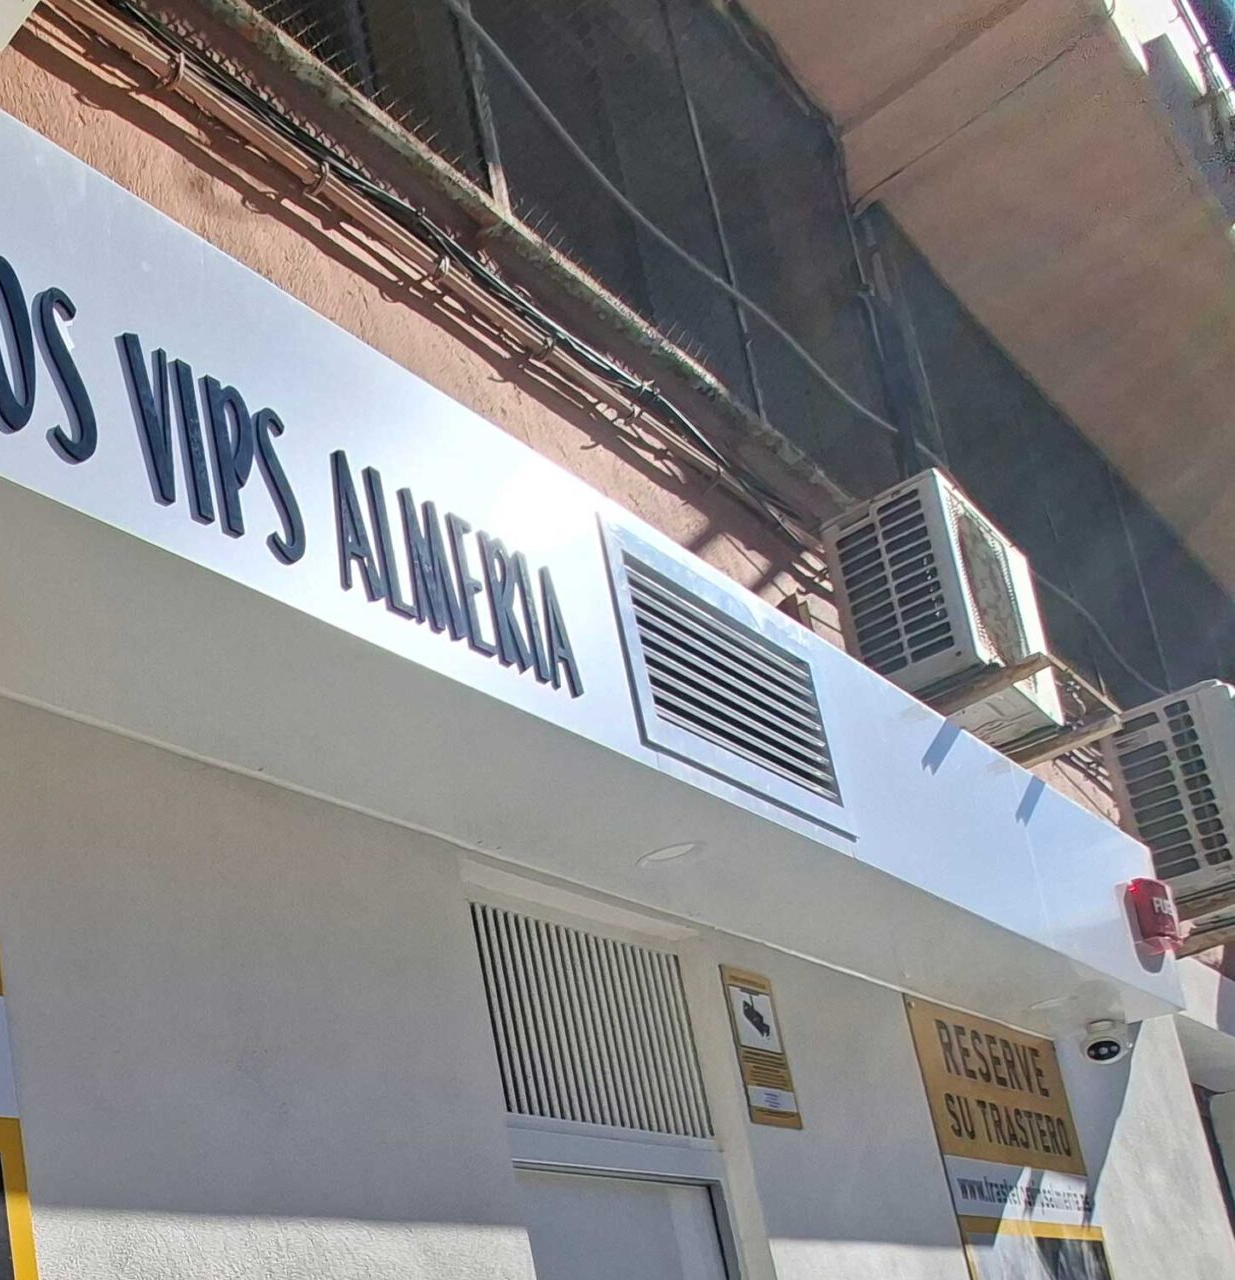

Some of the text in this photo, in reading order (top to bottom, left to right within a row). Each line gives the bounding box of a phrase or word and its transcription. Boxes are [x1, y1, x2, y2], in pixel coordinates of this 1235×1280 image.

[115, 332, 307, 566] VIPS
[330, 449, 585, 699] ALMERIA
[935, 1018, 1050, 1098] RESERVE
[944, 1092, 1072, 1157] SU TRASTERO
